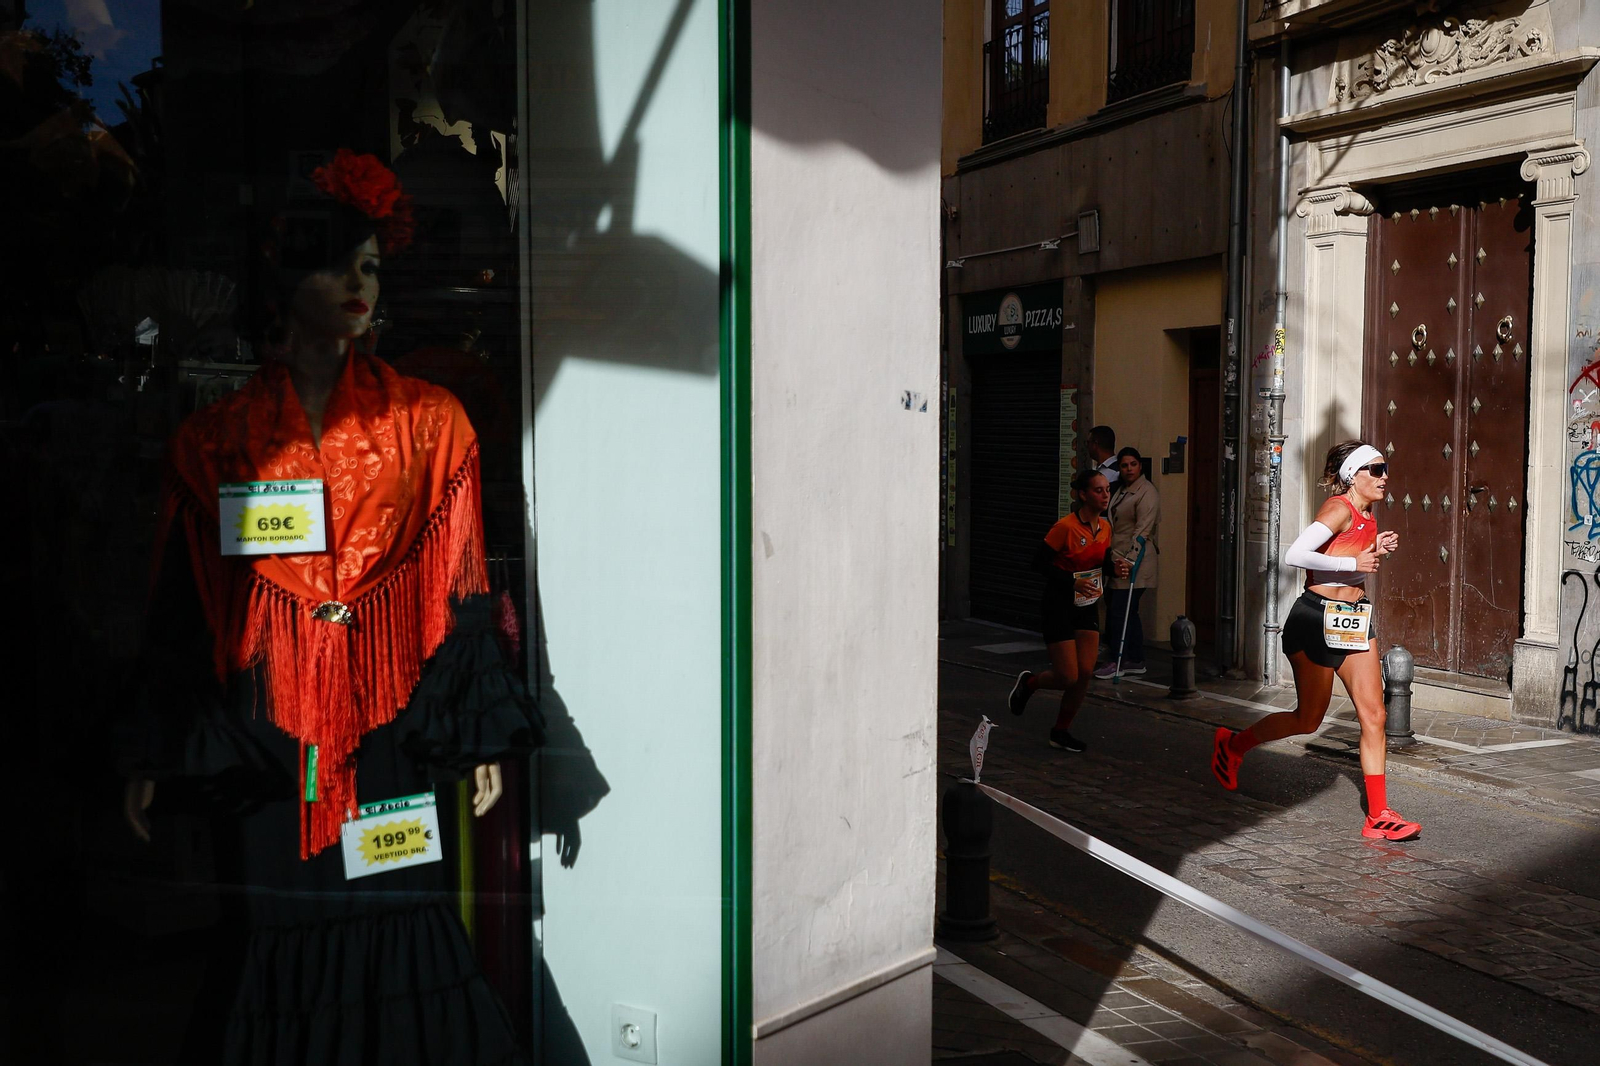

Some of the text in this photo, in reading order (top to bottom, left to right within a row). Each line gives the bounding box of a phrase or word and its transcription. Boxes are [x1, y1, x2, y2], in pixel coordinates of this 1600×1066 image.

[968, 313, 997, 334] LUXURY
[257, 516, 295, 531] 69€
[236, 534, 304, 543] MANTON BORDADO
[1332, 616, 1360, 629] 105
[374, 849, 409, 861] VESTIDO
